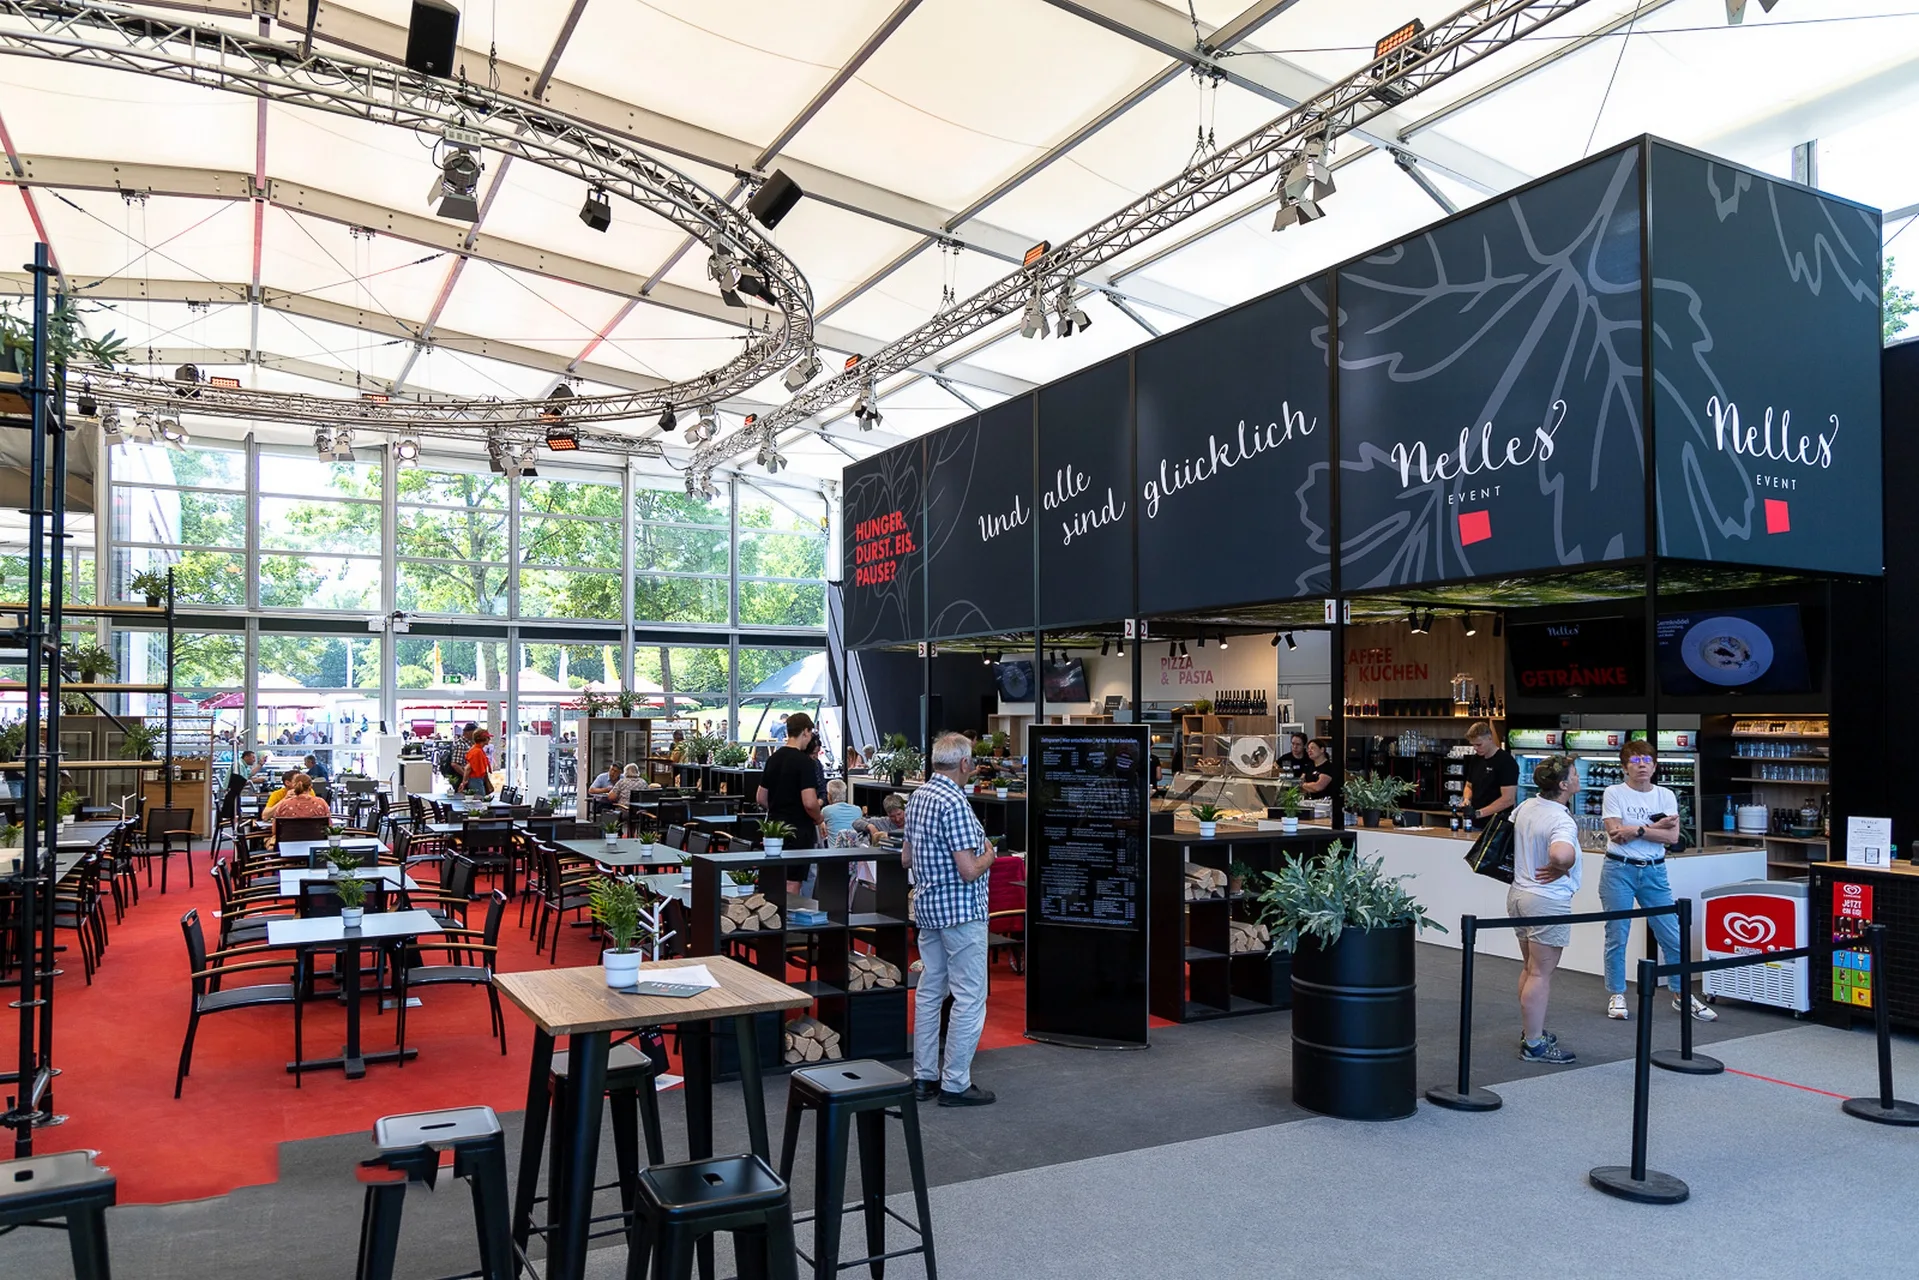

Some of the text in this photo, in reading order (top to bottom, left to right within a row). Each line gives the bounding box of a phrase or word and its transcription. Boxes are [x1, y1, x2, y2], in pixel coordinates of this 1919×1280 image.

[1391, 399, 1567, 488] Nelles
[1707, 395, 1839, 469] Nelles
[1144, 401, 1317, 518] glücklich
[1756, 474, 1797, 490] EVENT
[978, 464, 1091, 542] Und alle
[1448, 485, 1501, 505] EVENT
[856, 510, 907, 542] HUNGER.
[1062, 487, 1126, 546] sind
[856, 532, 916, 565] DURST. EIS.
[856, 560, 897, 587] PAUSE?
[1126, 621, 1132, 637] 2
[1546, 624, 1580, 637] Nelles
[1161, 656, 1193, 670] PIZZA
[1344, 647, 1393, 665] AFFEE
[1161, 670, 1214, 685] & PASTA
[1359, 663, 1429, 682] KUCHEN
[1521, 663, 1628, 688] GETRÄNKE
